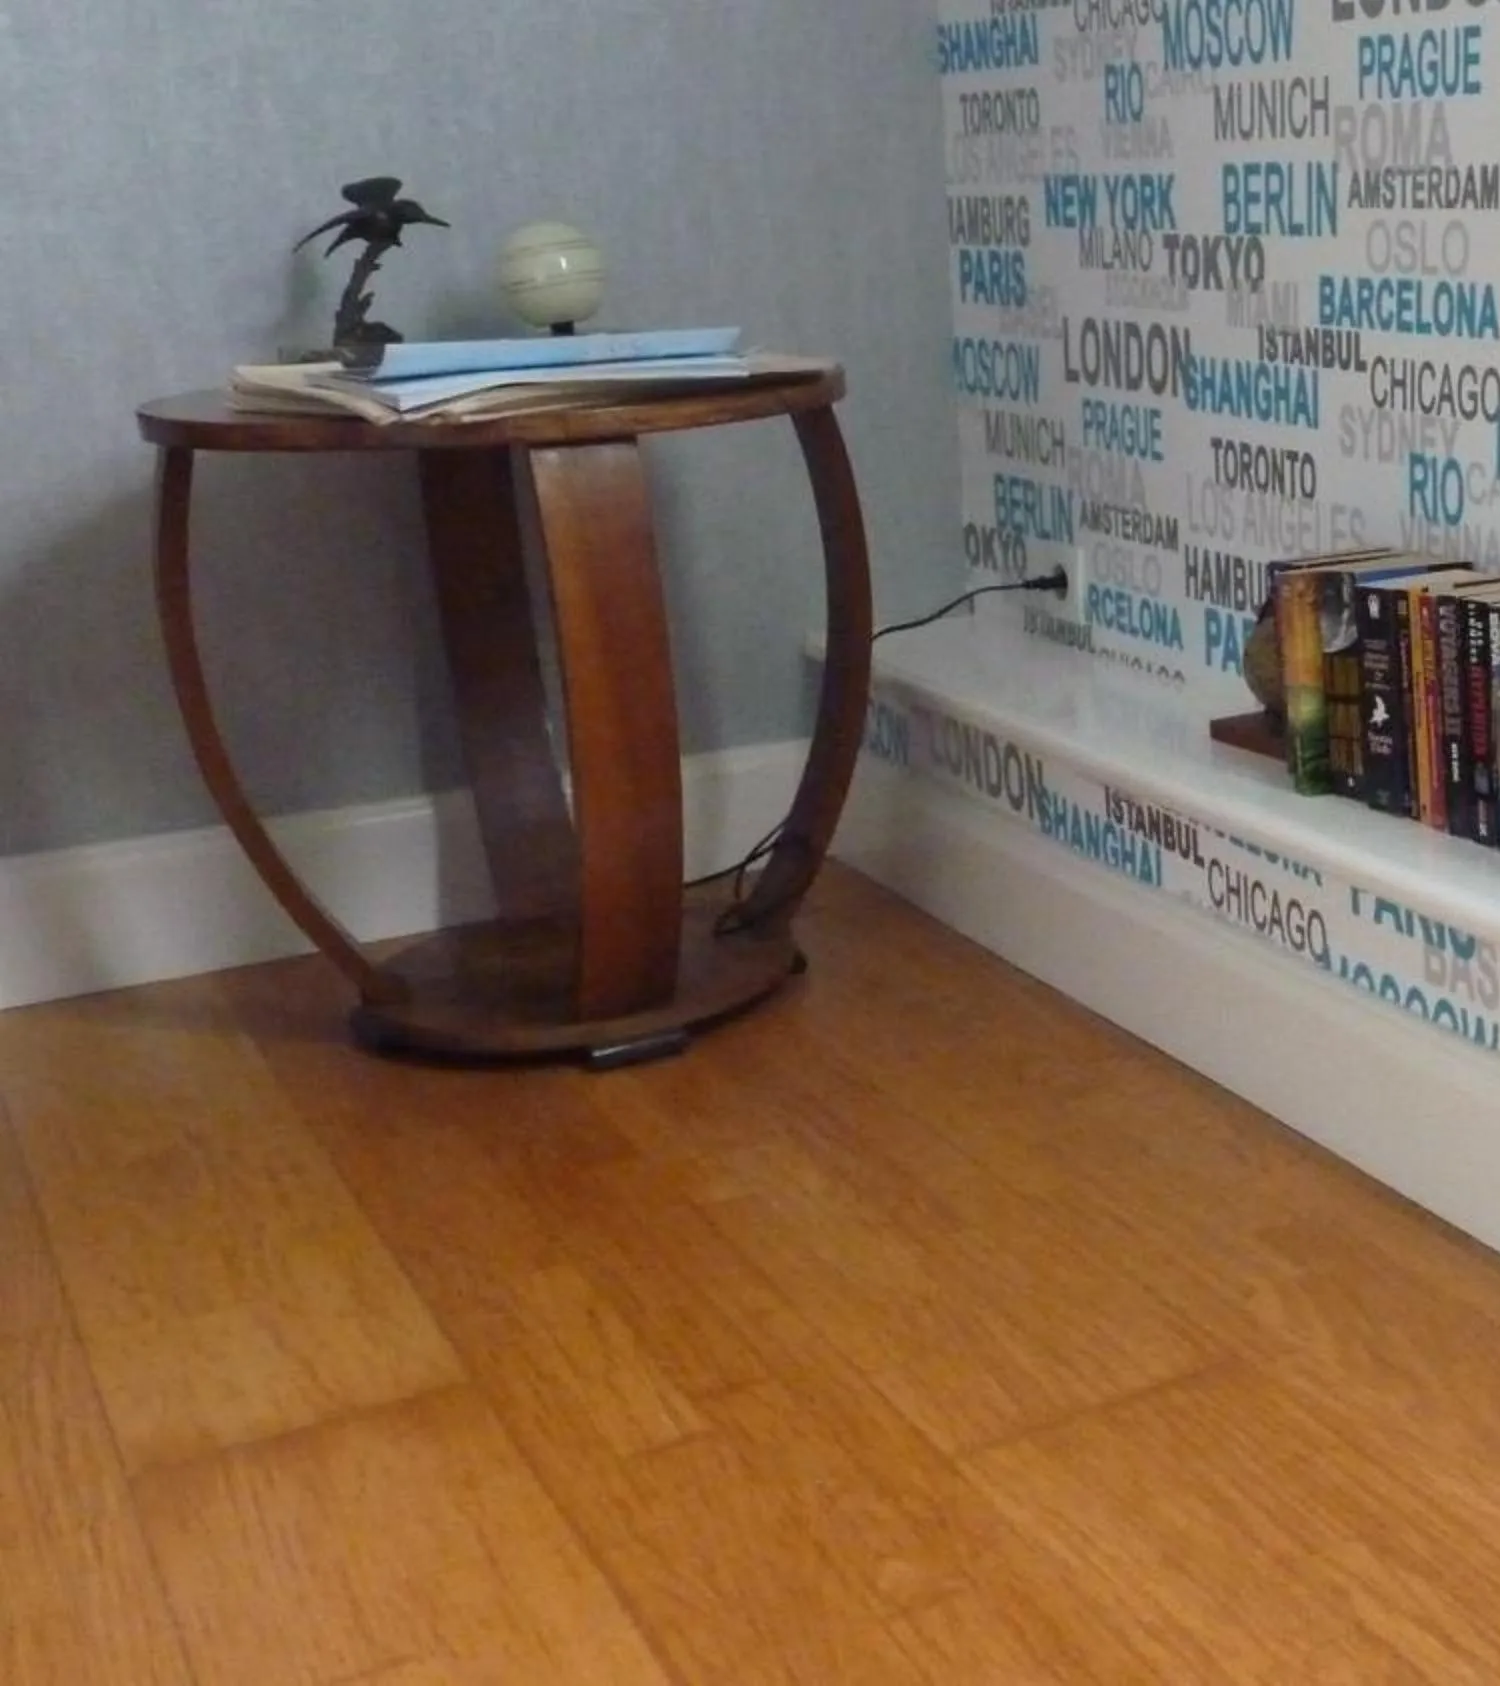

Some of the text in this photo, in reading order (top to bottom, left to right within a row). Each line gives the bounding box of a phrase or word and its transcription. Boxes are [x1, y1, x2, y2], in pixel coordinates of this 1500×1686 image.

[938, 13, 1039, 75] SHANGHAI
[1160, 0, 1294, 72] MOSCOW
[1357, 26, 1482, 100] PRAGUE
[958, 87, 1041, 136] TORONTO
[1103, 61, 1144, 124] RIO
[1213, 76, 1330, 141] MUNICH
[1334, 102, 1454, 172] ROMA
[1042, 173, 1177, 231] NEW YORK
[1221, 161, 1339, 237] BERLIN
[1347, 164, 1500, 210] AMSTERDAM
[959, 248, 1029, 309] PARIS
[1079, 226, 1154, 272] MILANO
[1162, 233, 1265, 291] TOKYO
[1366, 219, 1470, 276] OSLO
[1317, 275, 1500, 341] BARCELONA
[1062, 316, 1192, 398] LONDON
[1257, 326, 1368, 374] ISTANBUL
[1183, 353, 1320, 430] SHANGHAI
[984, 408, 1066, 469] MUNICH
[1081, 396, 1164, 461] PRAGUE
[1339, 404, 1459, 466] SYDNEY
[1210, 436, 1317, 501] TORONTO
[1408, 451, 1465, 527] RIO
[993, 471, 1075, 545] BERLIN
[1078, 499, 1179, 551] AMSTERDAM
[963, 521, 1028, 575] OKYO
[1184, 543, 1270, 618] HAMBU
[1085, 583, 1185, 652] RCELONA
[1037, 784, 1164, 889] SHANGHAI
[1103, 784, 1206, 869] ISTANBUL
[1206, 857, 1332, 973] CHICAGO
